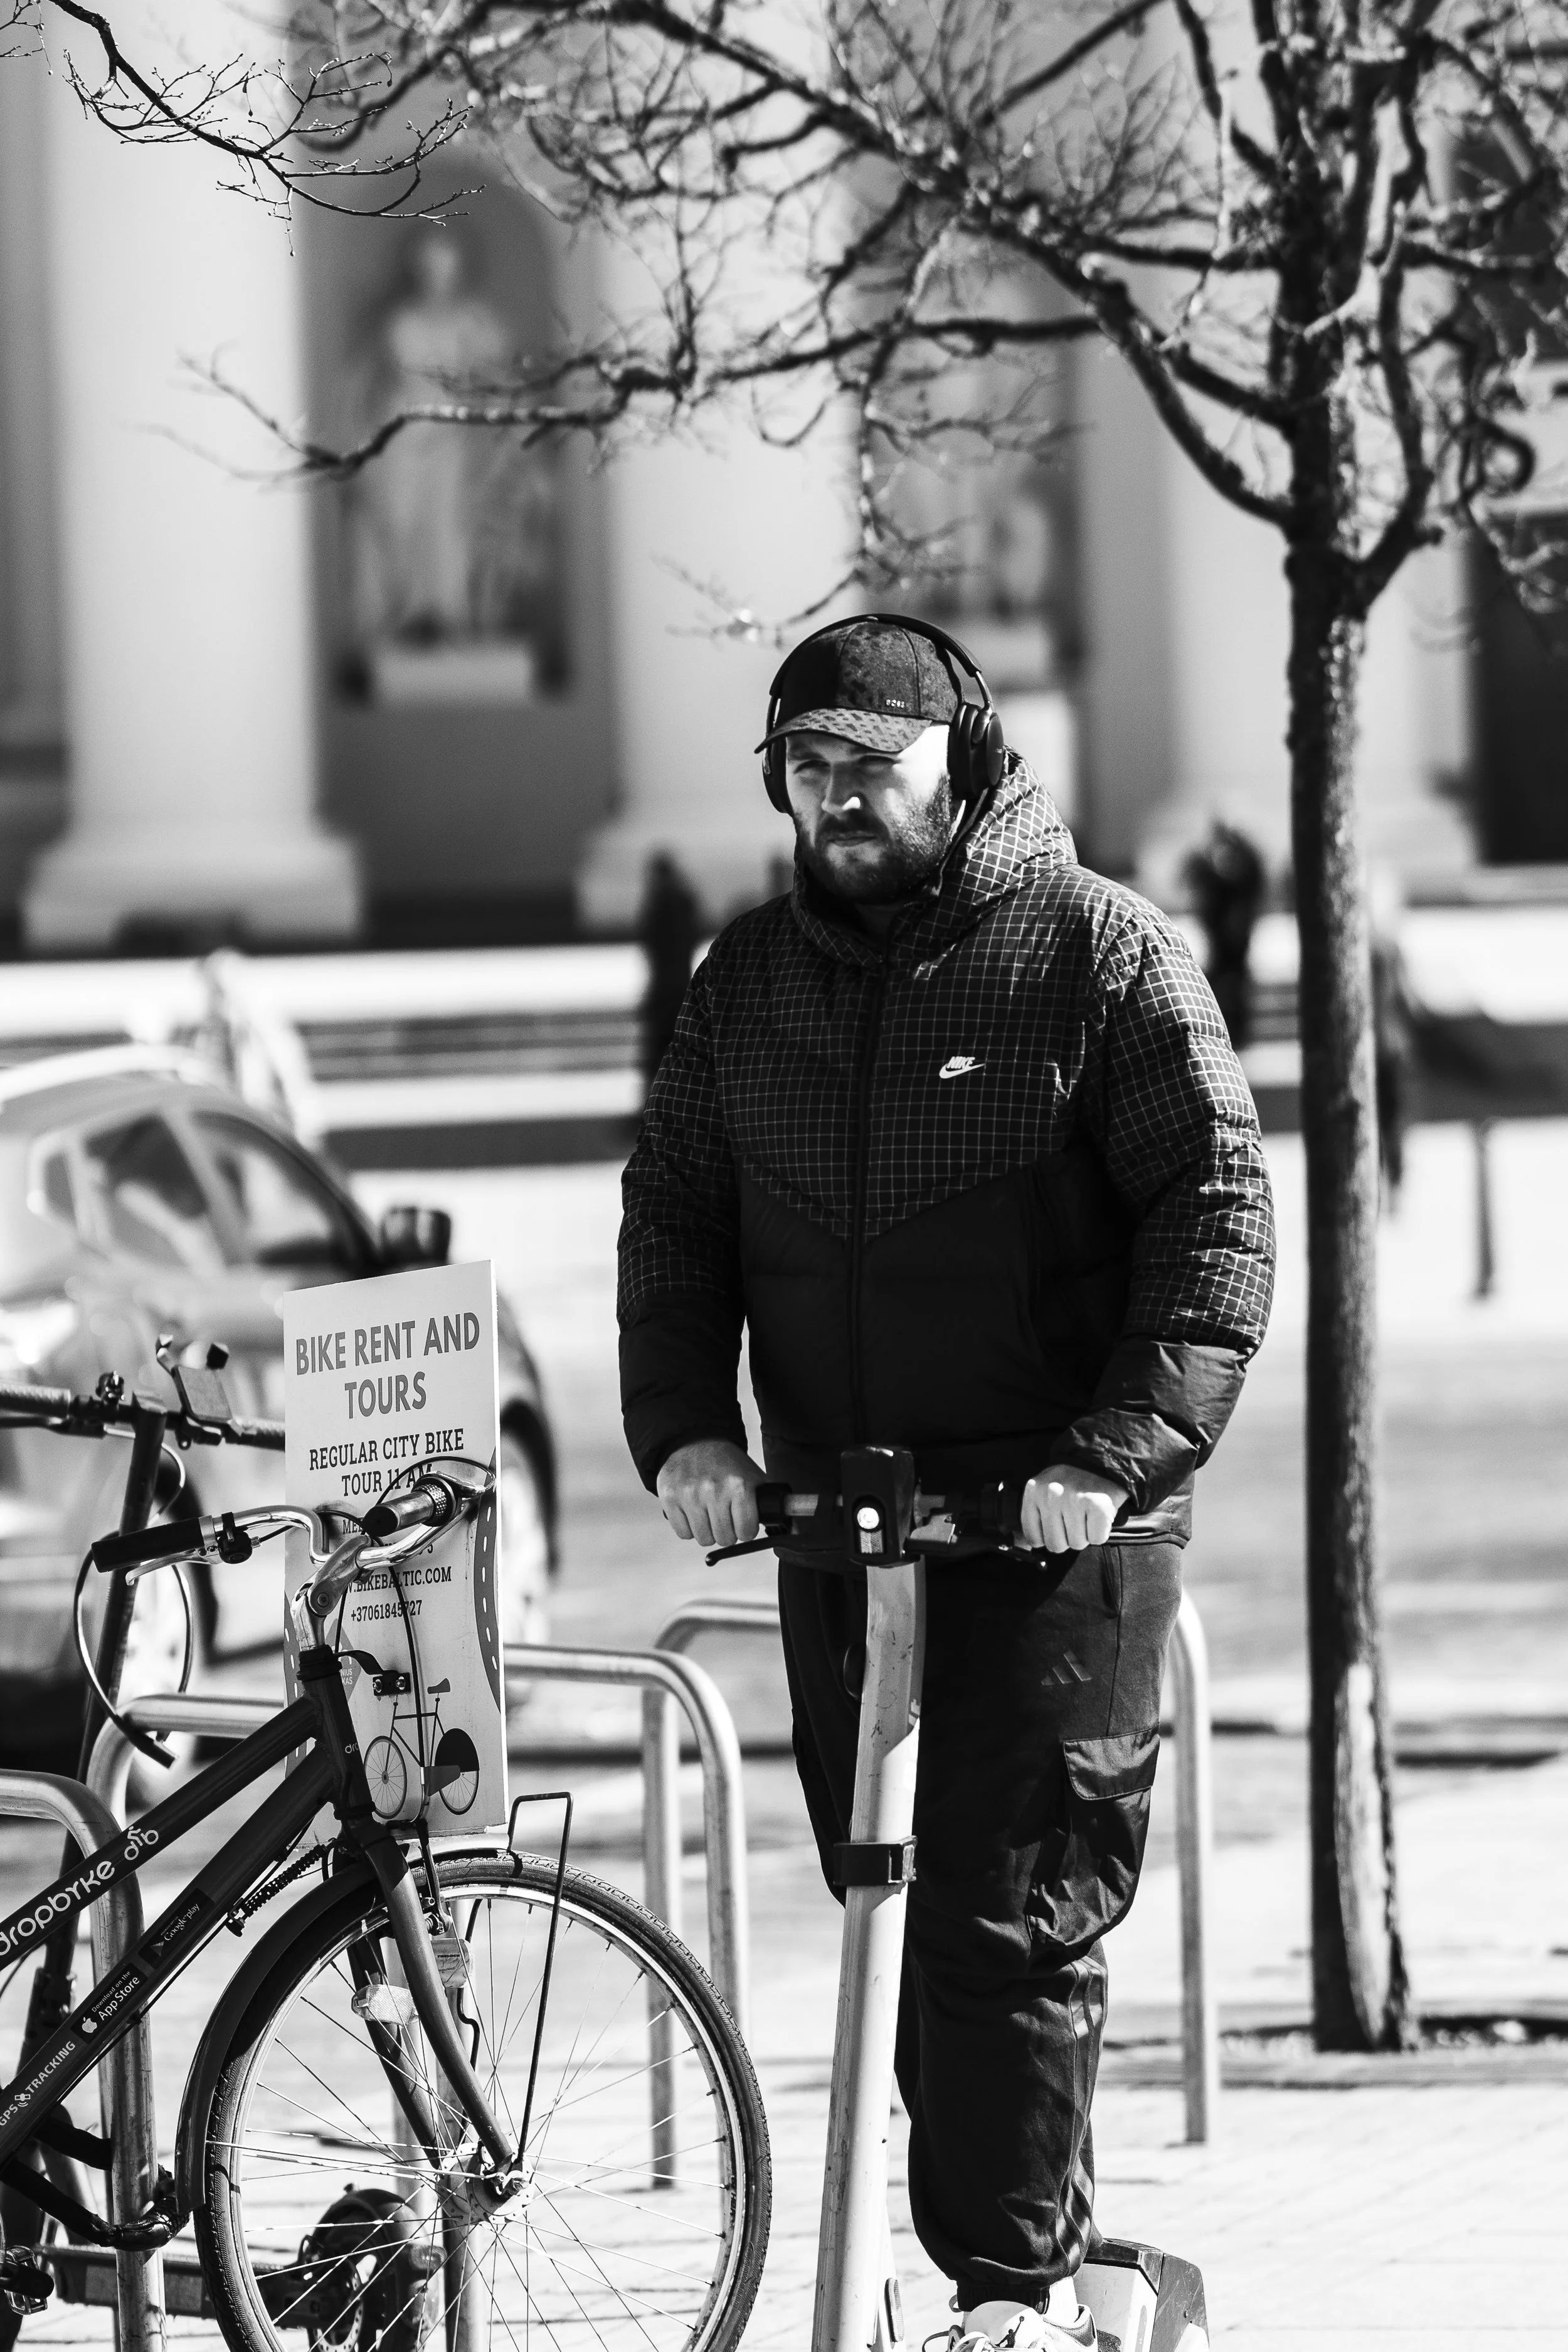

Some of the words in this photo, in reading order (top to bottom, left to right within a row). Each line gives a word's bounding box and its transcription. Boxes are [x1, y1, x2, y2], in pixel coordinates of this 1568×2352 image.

[296, 1332, 346, 1375] BIKE
[354, 1320, 415, 1366] RENT
[423, 1312, 480, 1356] AND
[344, 1371, 426, 1419] TOURS
[309, 1440, 378, 1470] REGULAR
[383, 1433, 420, 1459] CITY
[425, 1428, 464, 1454] BIKE
[342, 1471, 382, 1496] TOUR
[388, 1468, 401, 1490] 11
[164, 1919, 187, 1941] Google
[186, 1903, 199, 1919] play
[92, 1986, 115, 2012] Download
[122, 1971, 130, 1980] the
[98, 2000, 118, 2021] App
[114, 1977, 139, 2001] Store
[0, 2104, 18, 2126] GPS
[25, 2041, 76, 2094] TRACKING
